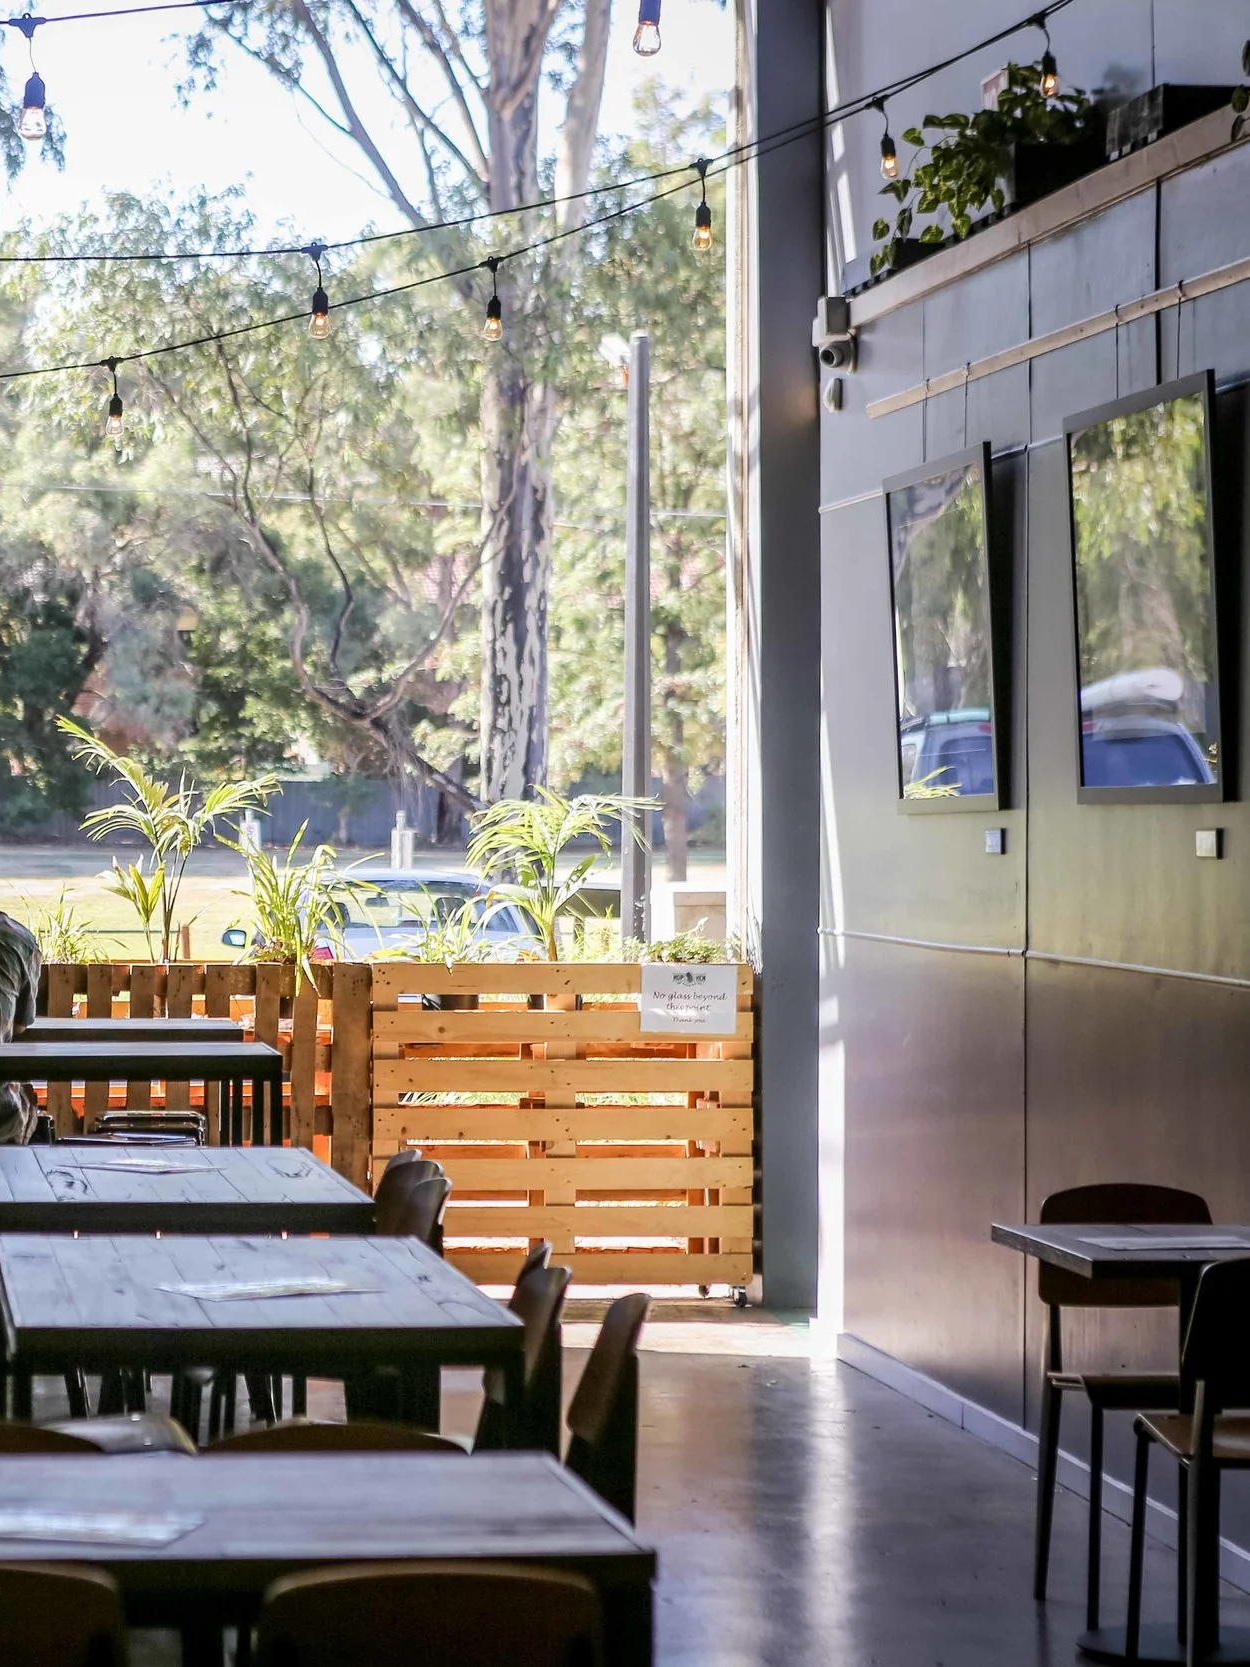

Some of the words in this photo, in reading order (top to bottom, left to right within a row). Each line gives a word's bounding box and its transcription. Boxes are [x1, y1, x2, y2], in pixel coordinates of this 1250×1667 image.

[653, 991, 666, 999] No
[667, 991, 691, 1001] glass
[693, 992, 728, 1002] beyond
